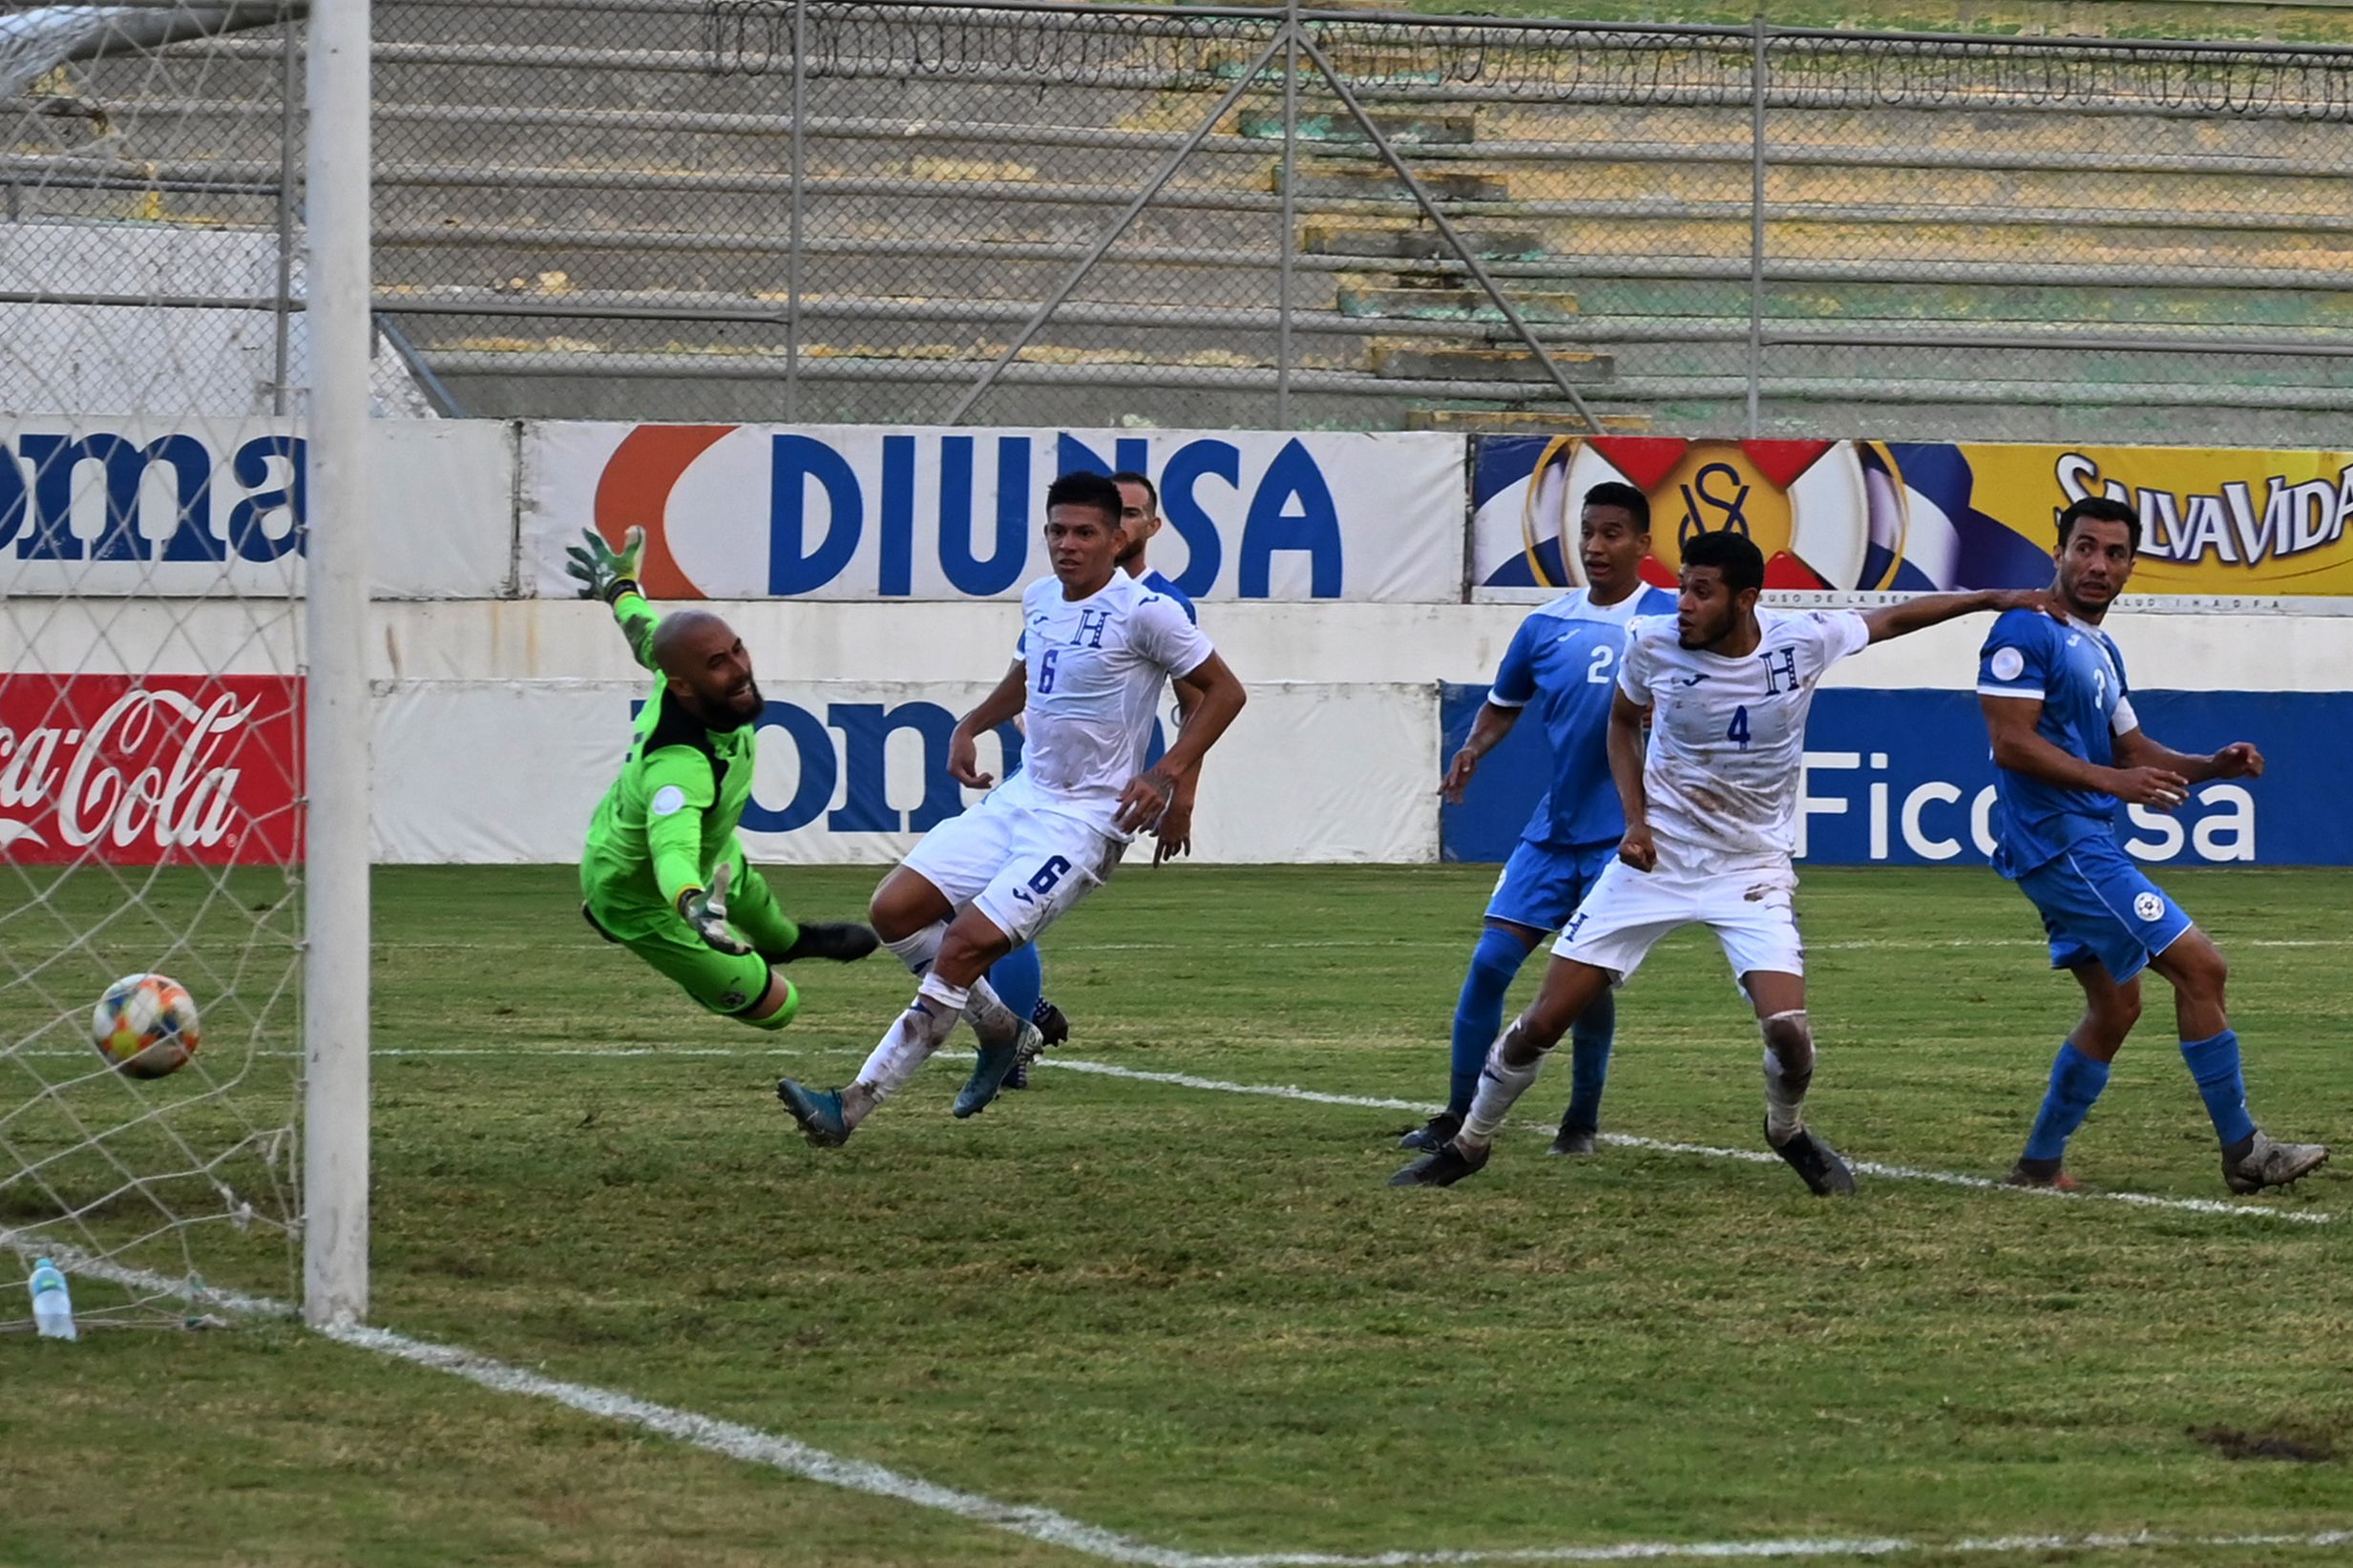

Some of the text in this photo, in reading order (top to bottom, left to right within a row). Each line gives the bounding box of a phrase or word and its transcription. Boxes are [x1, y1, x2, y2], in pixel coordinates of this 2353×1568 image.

[0, 432, 308, 563] ma
[767, 434, 1343, 598] DIUSA
[1038, 649, 1059, 695] 6
[1727, 705, 1751, 750] 4
[1027, 854, 1072, 894] 6
